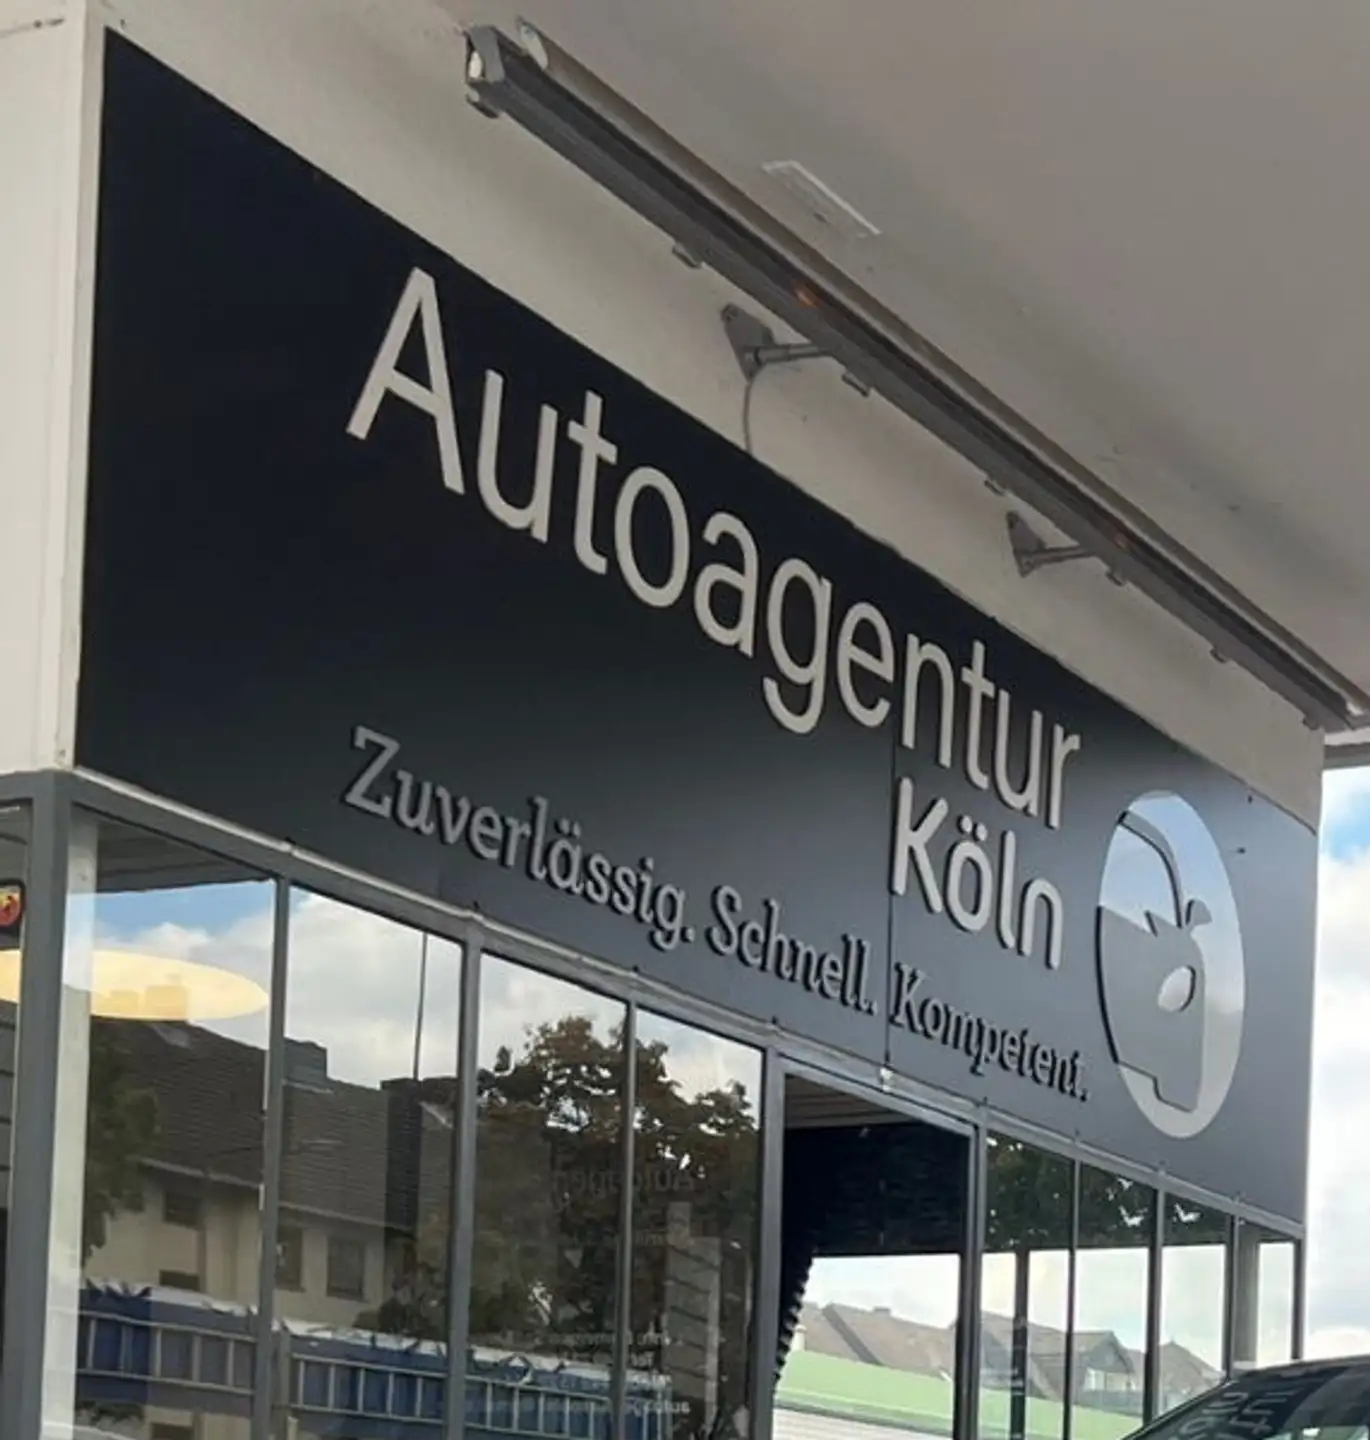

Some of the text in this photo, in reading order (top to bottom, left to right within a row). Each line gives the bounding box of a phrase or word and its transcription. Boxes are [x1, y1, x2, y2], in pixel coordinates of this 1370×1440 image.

[346, 267, 1081, 831] Autoagentur
[345, 725, 1090, 1102] Zuverlässig. Schnell. Kompetent.
[891, 777, 1063, 970] Köln
